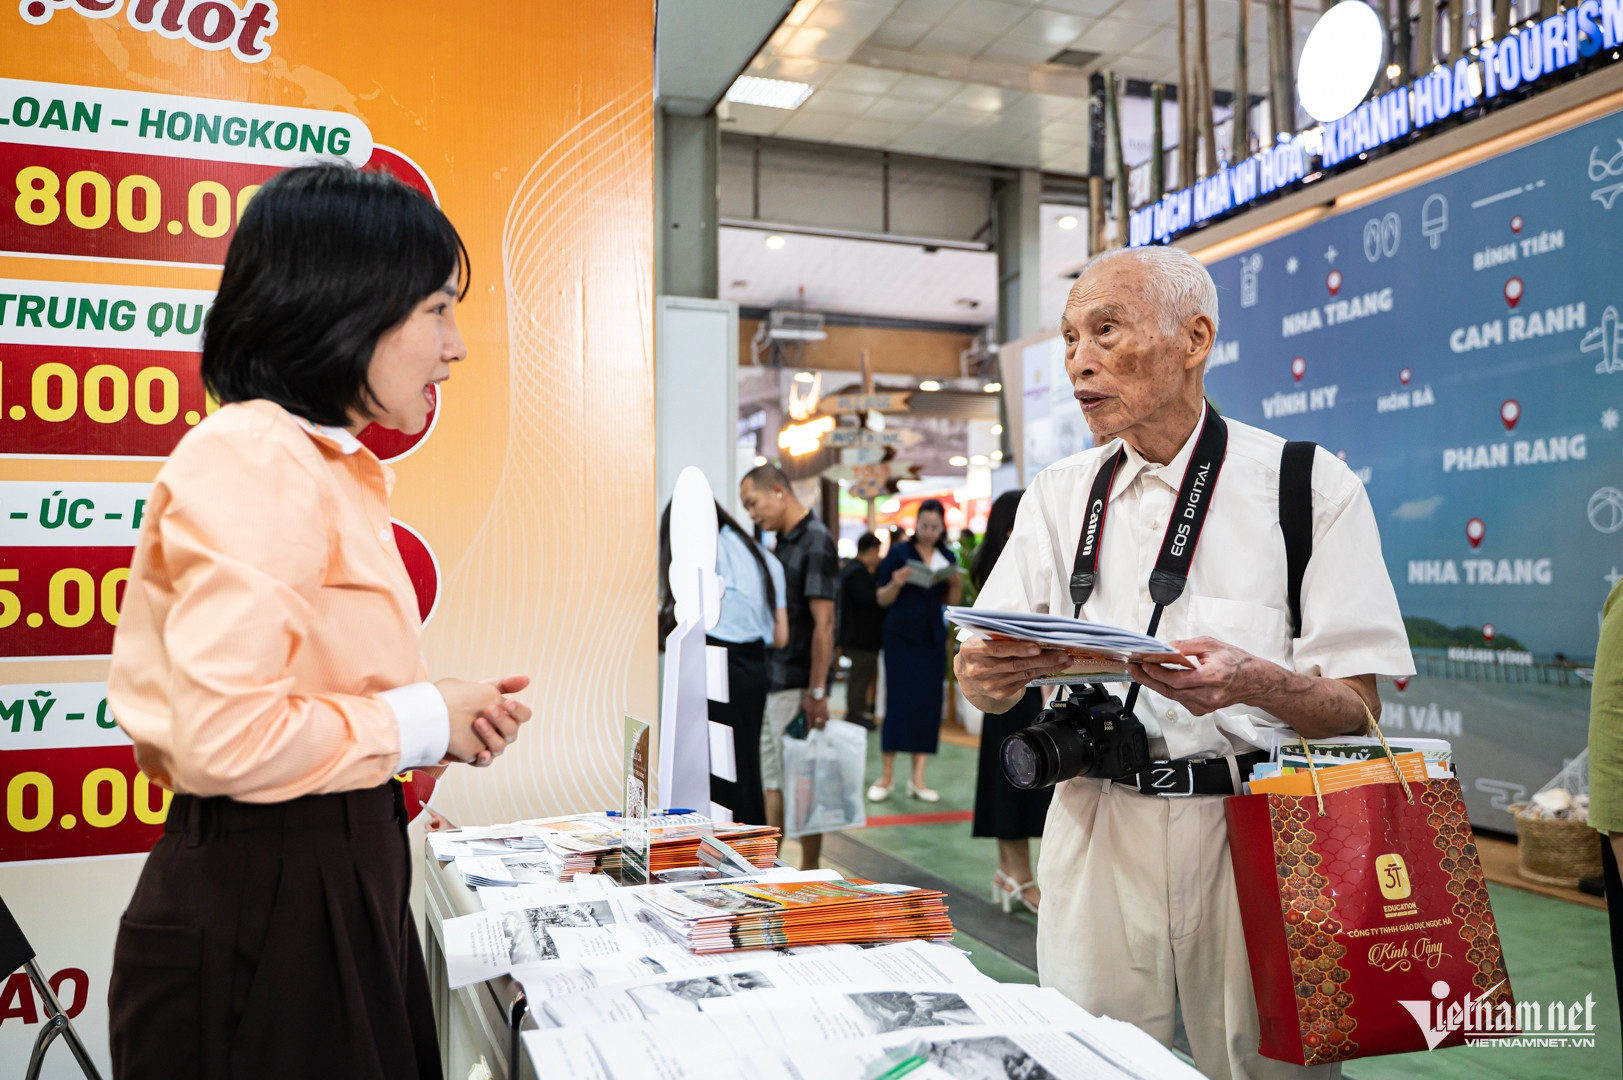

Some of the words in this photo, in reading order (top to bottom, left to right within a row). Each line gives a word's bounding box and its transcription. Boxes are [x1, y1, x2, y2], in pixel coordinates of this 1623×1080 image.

[0, 96, 102, 133] OAN
[139, 108, 351, 156] HONGKONG
[1129, 207, 1151, 247] DU
[147, 301, 213, 337] QU
[1282, 307, 1322, 338] NHA
[1324, 286, 1393, 326] TRANG
[1450, 320, 1503, 353] CAM
[1507, 301, 1586, 342] RANH
[1309, 384, 1338, 411] HY
[1443, 444, 1508, 472] PHAN
[1514, 434, 1587, 465] RANG
[39, 490, 95, 529] ÚC
[1082, 498, 1103, 556] Canon
[1171, 523, 1191, 557] EOS
[1183, 462, 1211, 519] DIGITAL
[1407, 560, 1459, 584] NHA
[1463, 558, 1553, 585] TRANG
[1383, 902, 1417, 912] EDUCATION
[1348, 928, 1370, 938] CÔNG
[1380, 925, 1399, 934] TNHH
[1368, 940, 1411, 972] Kính
[1411, 937, 1453, 969] Tặng
